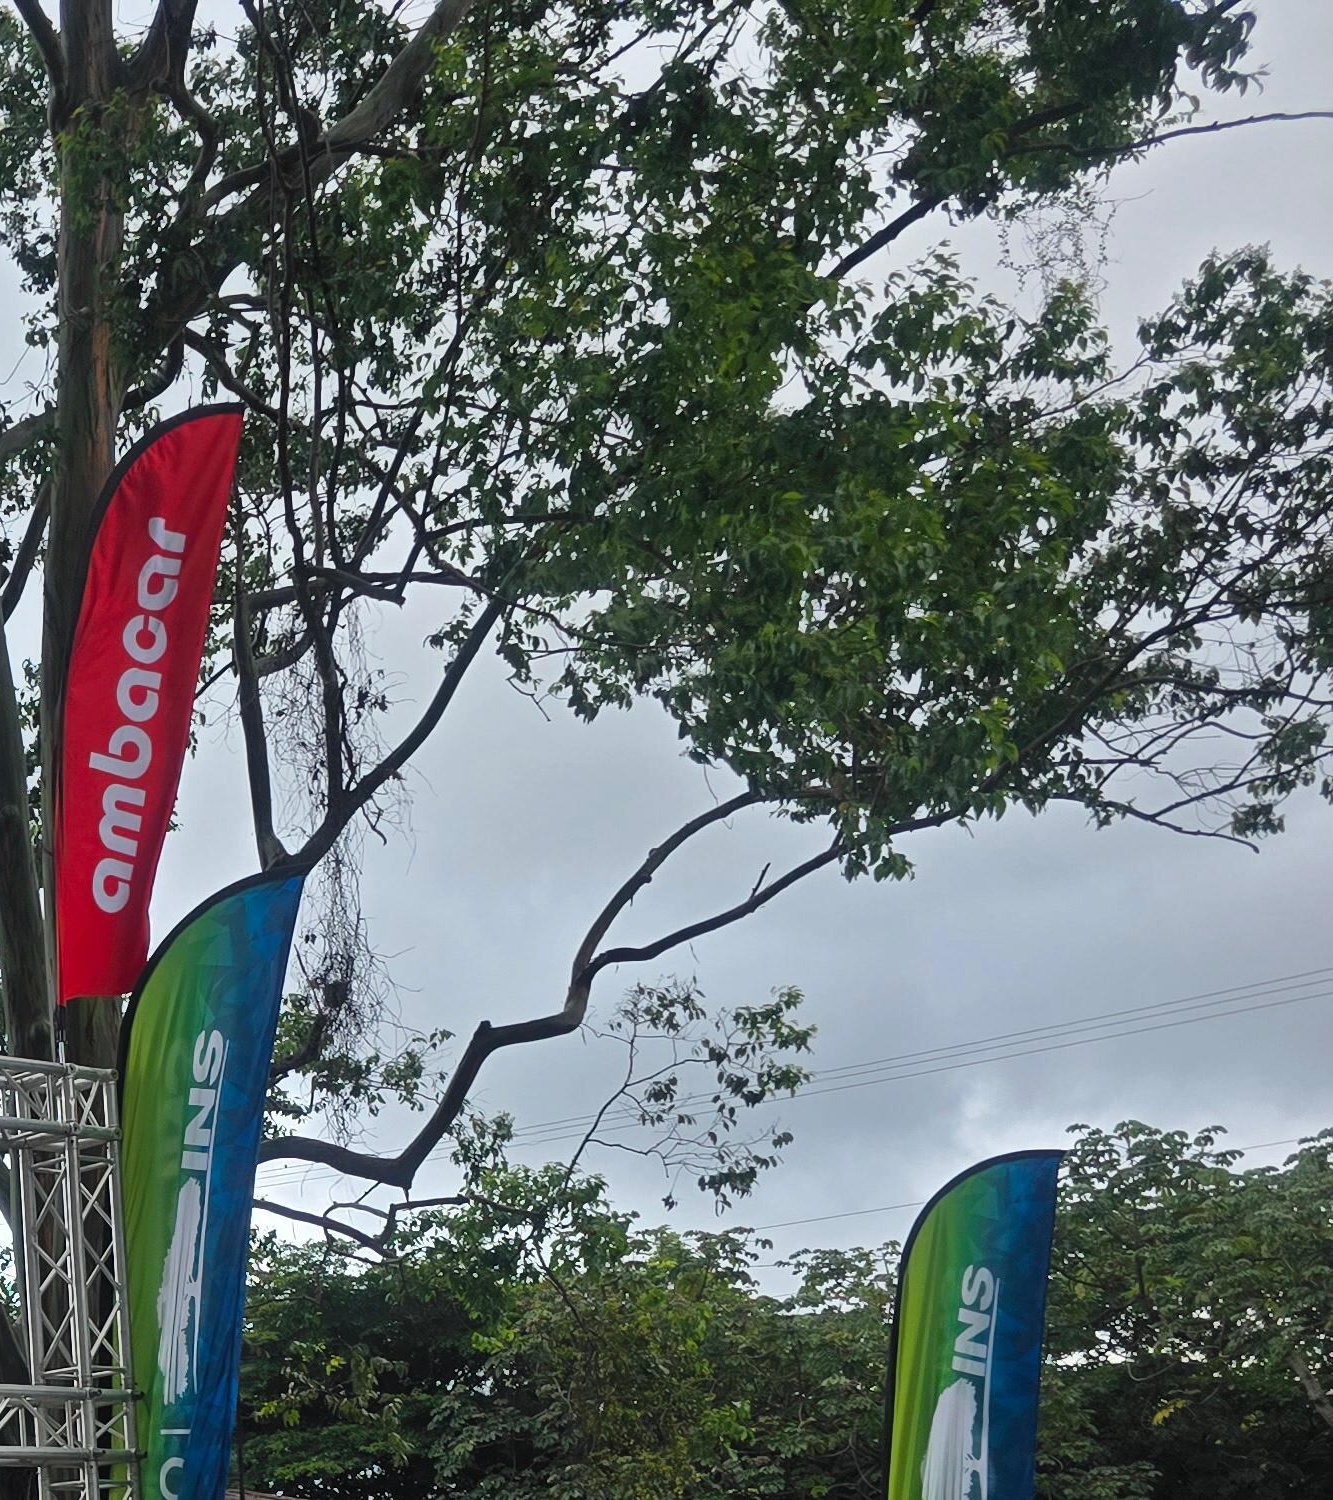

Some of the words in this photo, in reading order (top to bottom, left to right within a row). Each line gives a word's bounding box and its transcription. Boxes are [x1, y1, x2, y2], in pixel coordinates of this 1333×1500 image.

[91, 514, 190, 916] ambacar
[180, 1028, 223, 1172] INS
[951, 1264, 996, 1379] INS
